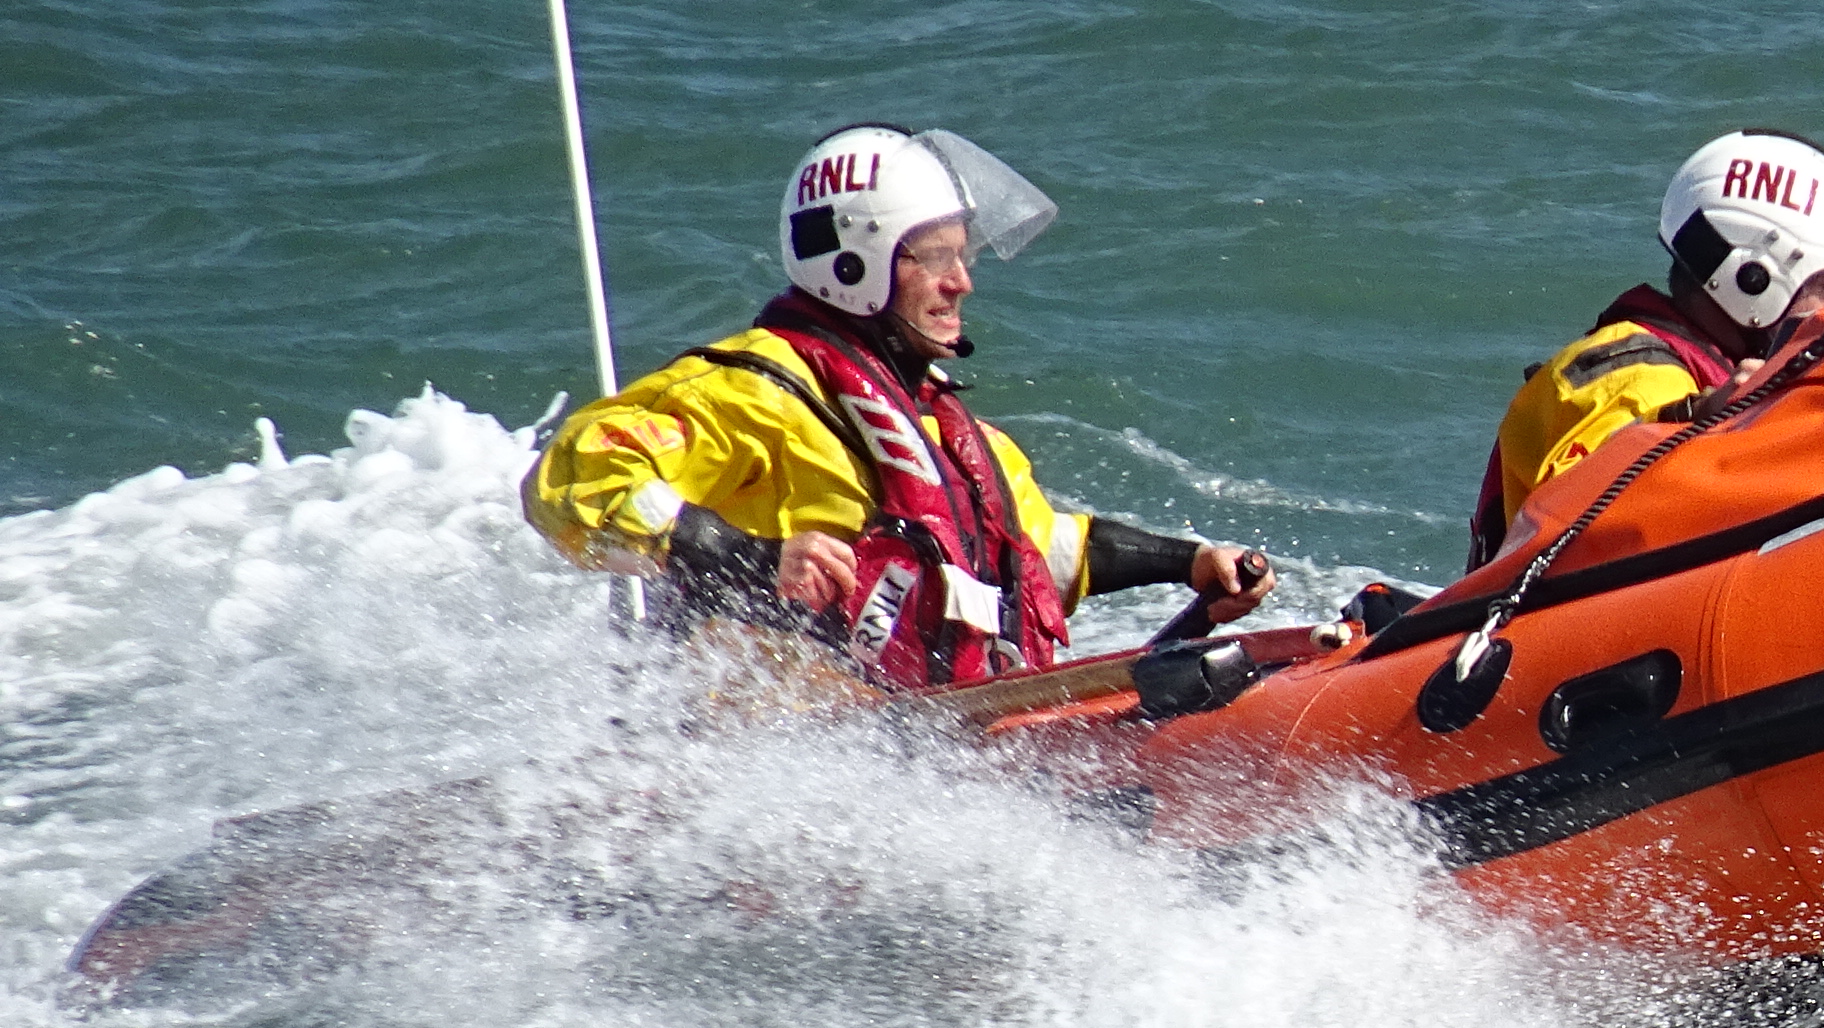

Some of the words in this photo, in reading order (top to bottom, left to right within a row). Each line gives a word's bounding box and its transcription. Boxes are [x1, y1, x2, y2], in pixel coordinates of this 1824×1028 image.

[798, 153, 881, 206] RNLI
[1722, 158, 1819, 217] RNLI
[855, 577, 905, 654] RNLI
